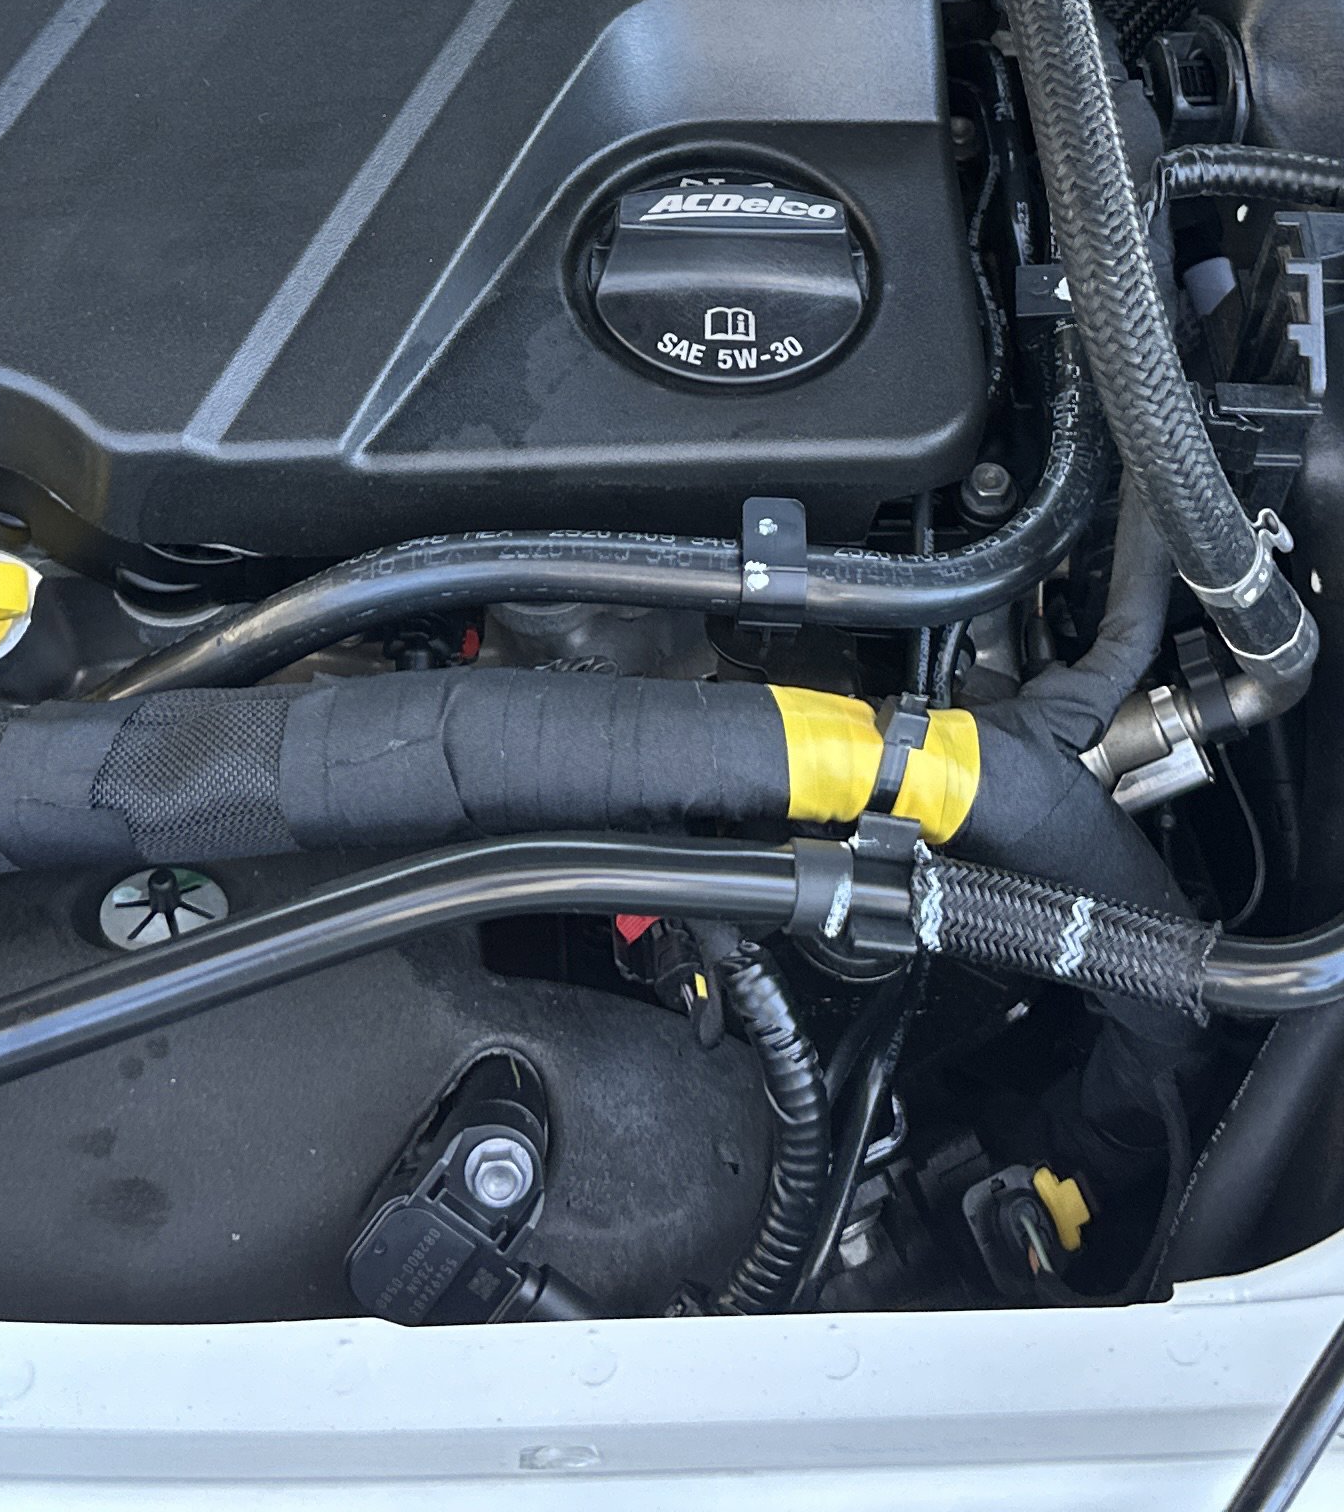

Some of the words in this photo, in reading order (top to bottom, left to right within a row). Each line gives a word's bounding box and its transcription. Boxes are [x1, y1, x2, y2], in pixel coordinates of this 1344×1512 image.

[647, 193, 837, 220] ACDelco
[656, 331, 707, 366] SAE
[717, 335, 804, 370] 5W-30
